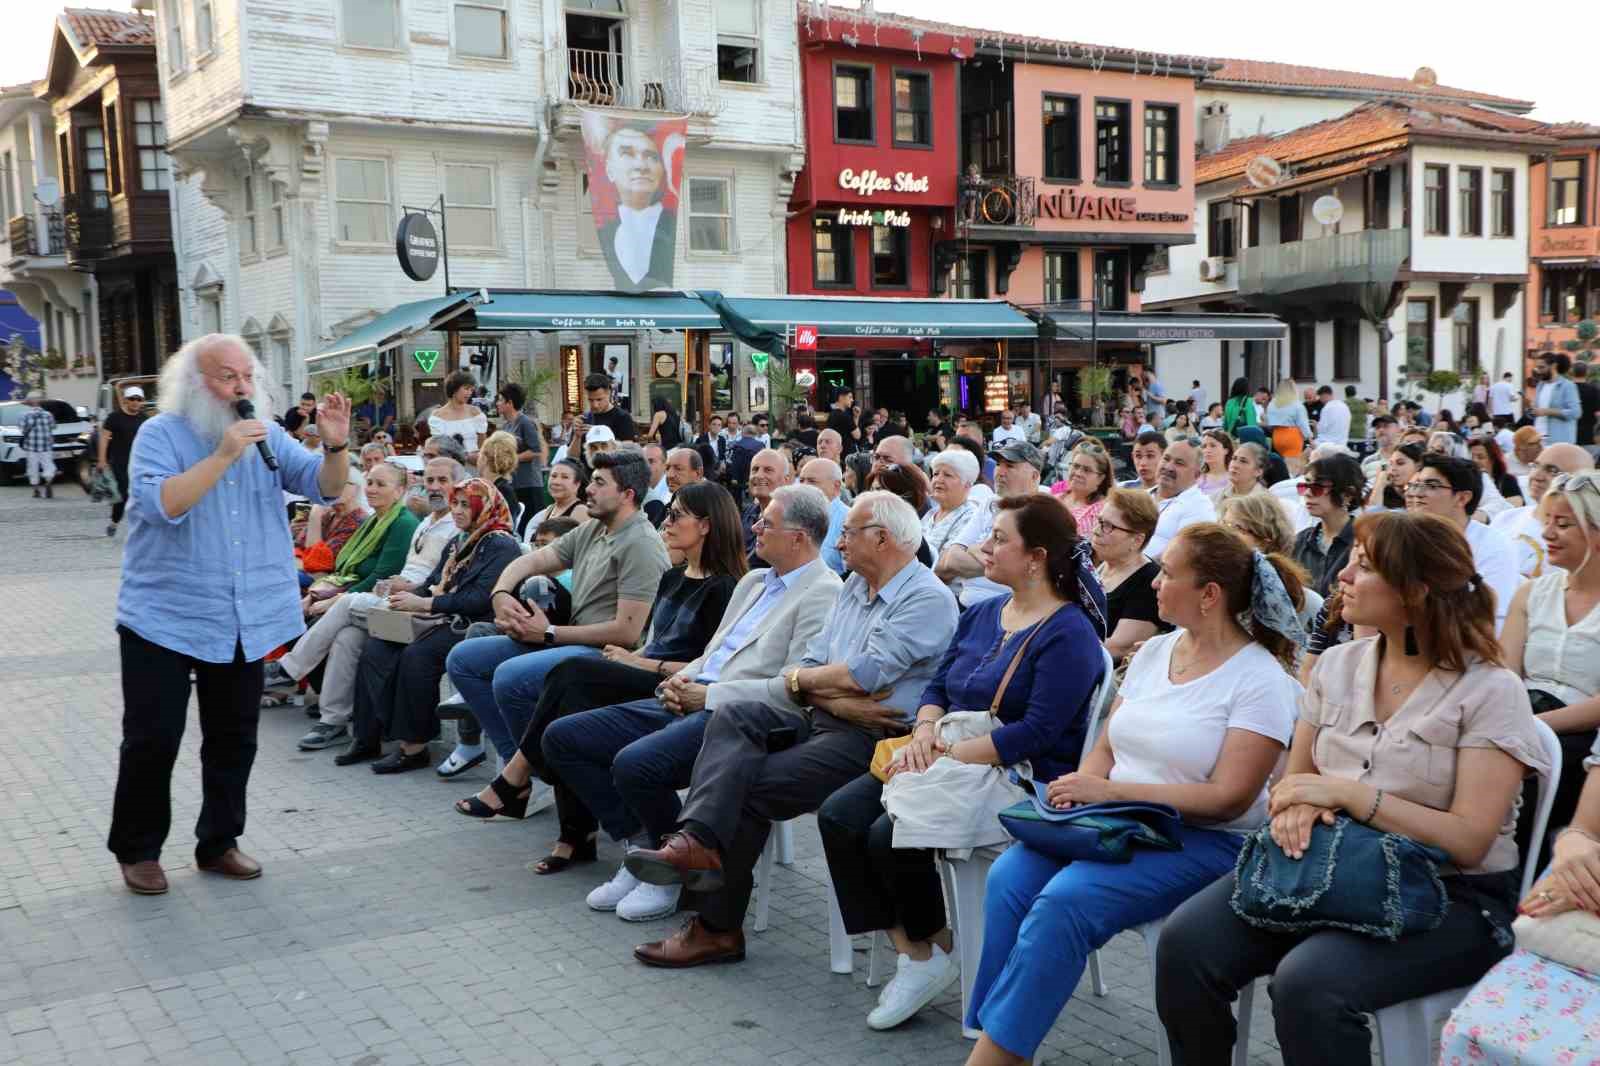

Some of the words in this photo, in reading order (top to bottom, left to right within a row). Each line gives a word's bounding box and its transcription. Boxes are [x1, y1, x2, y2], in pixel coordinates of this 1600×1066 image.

[839, 168, 892, 196] Coffee
[894, 171, 929, 193] Shot
[1037, 188, 1137, 220] NÜANS
[838, 207, 873, 226] Irish
[884, 209, 911, 227] Pub
[800, 330, 816, 345] illy
